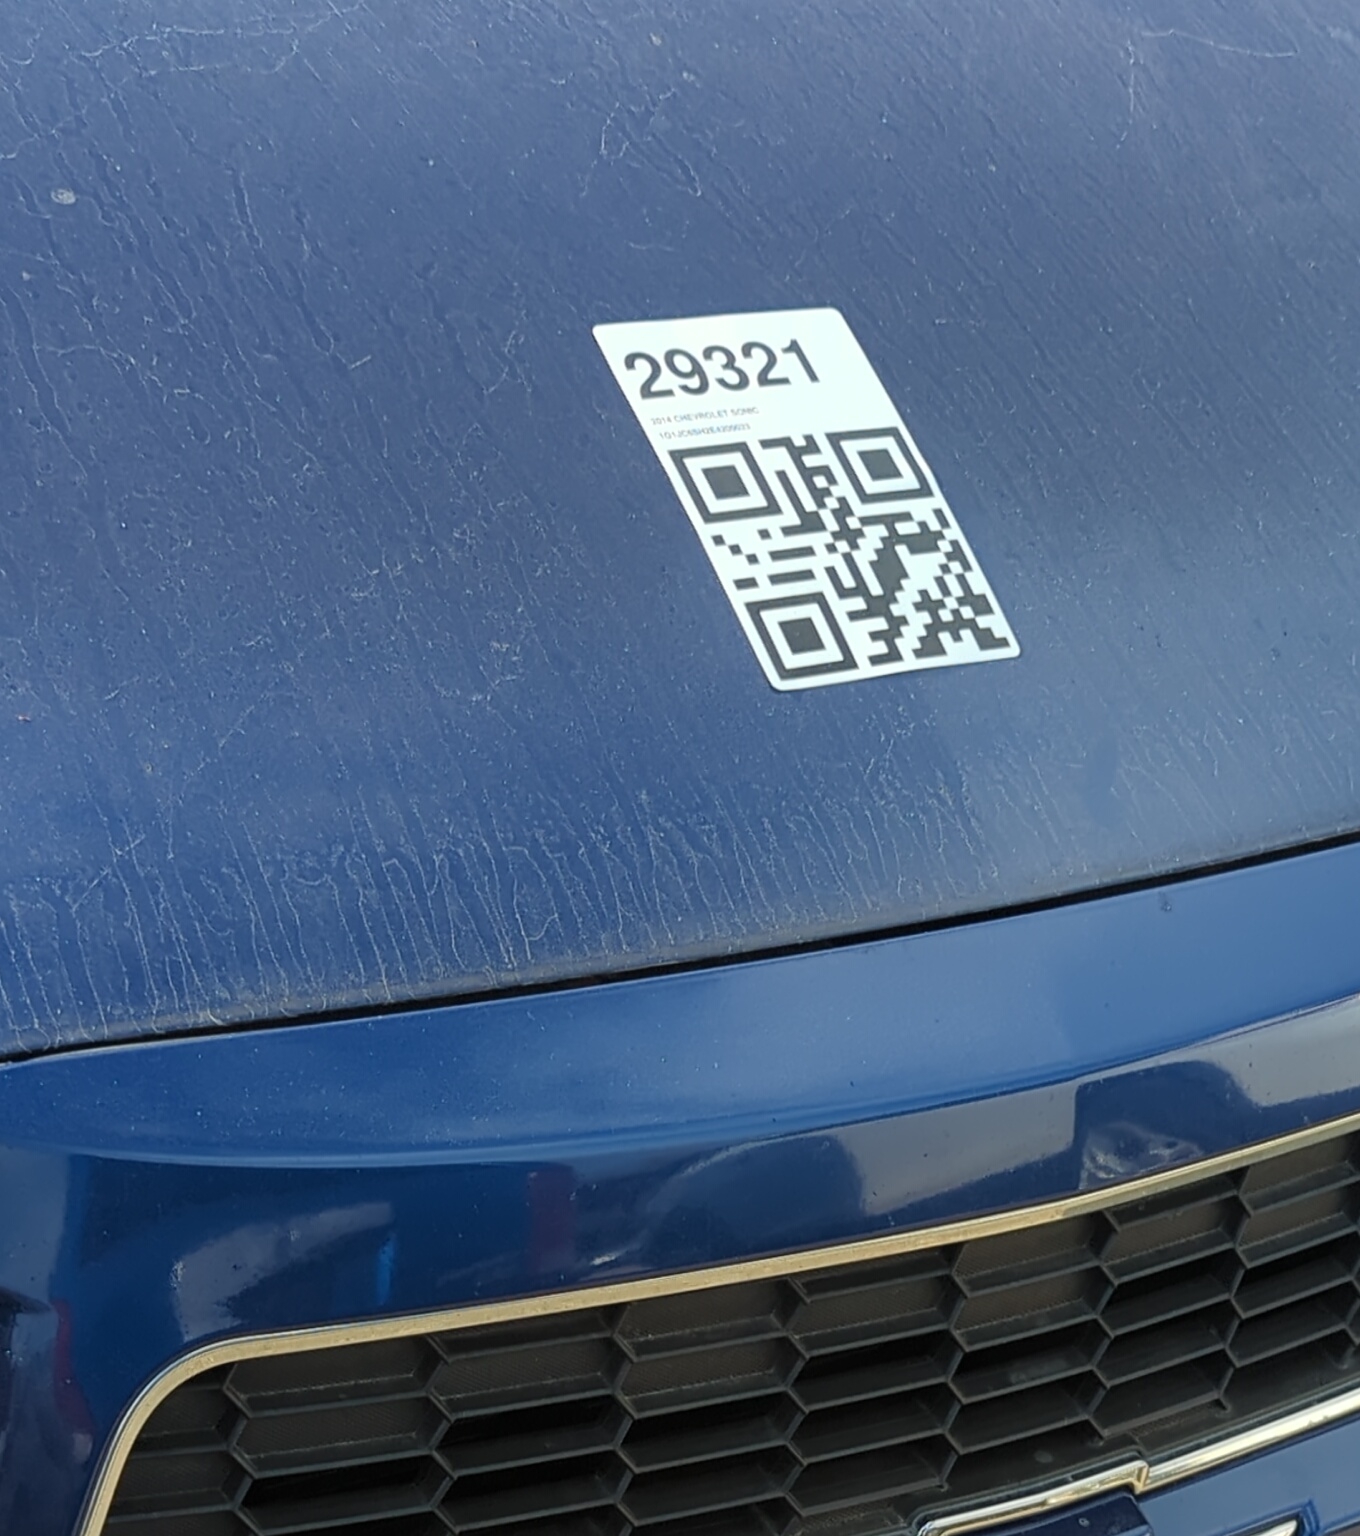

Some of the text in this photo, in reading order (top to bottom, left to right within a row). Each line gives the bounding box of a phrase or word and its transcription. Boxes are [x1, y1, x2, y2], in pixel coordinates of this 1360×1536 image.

[624, 338, 820, 400] 29321
[651, 406, 760, 425] 2014 CHEVROLET SONIC
